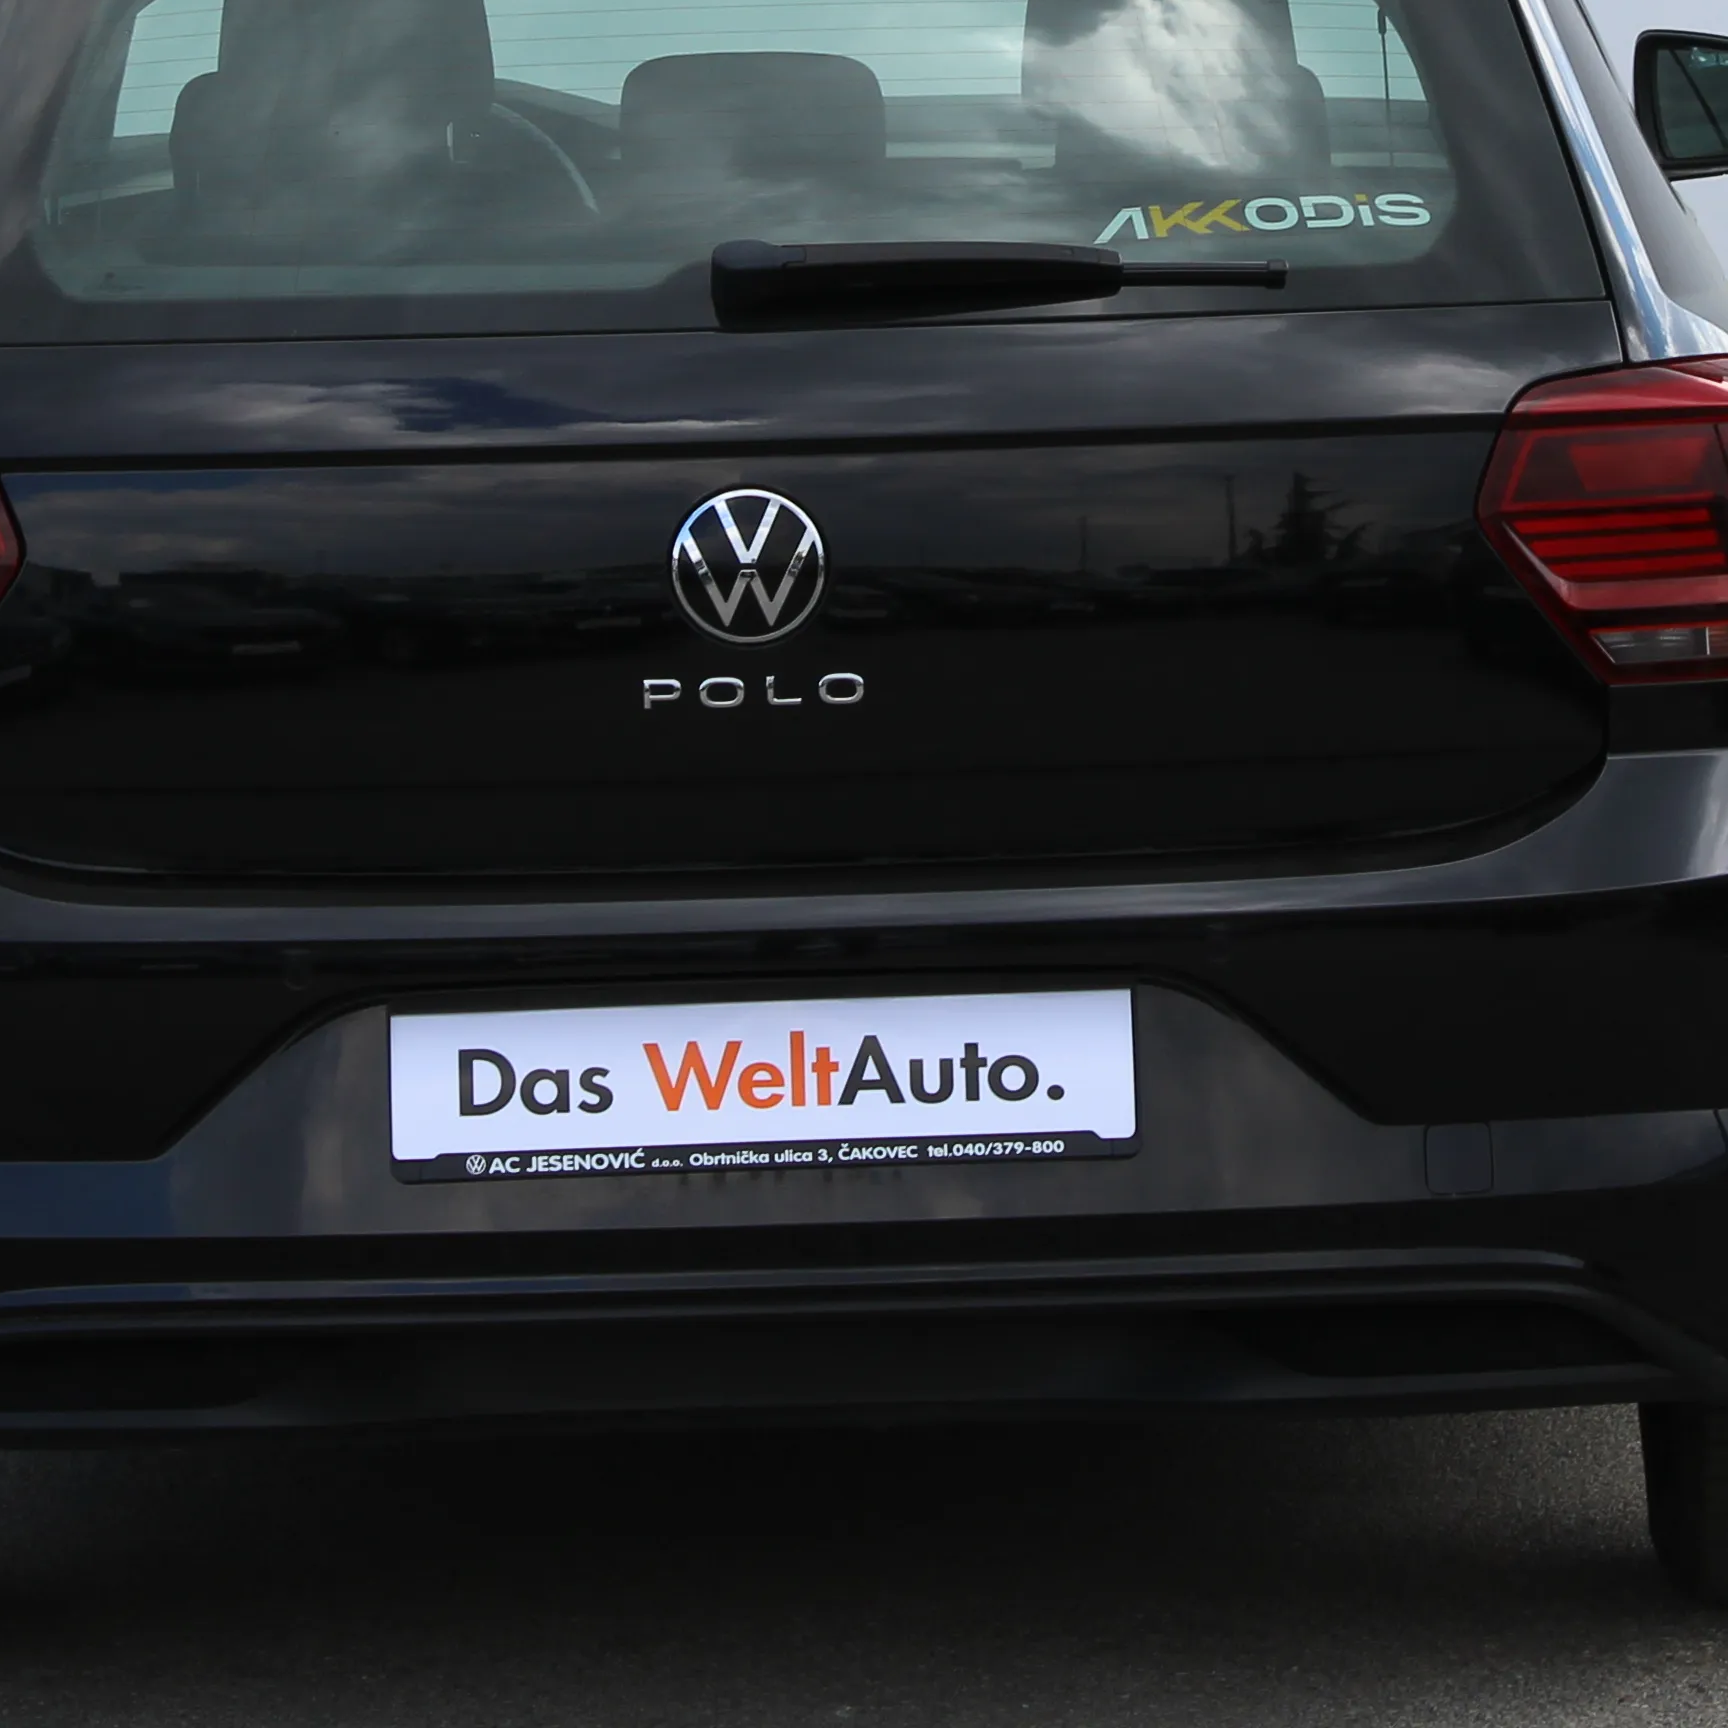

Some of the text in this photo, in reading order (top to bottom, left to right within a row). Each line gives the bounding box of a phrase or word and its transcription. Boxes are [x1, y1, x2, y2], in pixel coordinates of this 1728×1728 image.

[642, 672, 865, 709] POLO
[458, 1030, 1065, 1117] Das WeltAuto.
[488, 1156, 521, 1174] AC
[525, 1148, 646, 1173] JESENOVIĆ
[651, 1157, 684, 1168] d.o.o.
[688, 1150, 770, 1167] Obrtnička
[773, 1148, 813, 1164] ulica
[817, 1148, 834, 1164] 3,
[837, 1143, 919, 1161] ČAKOVEC
